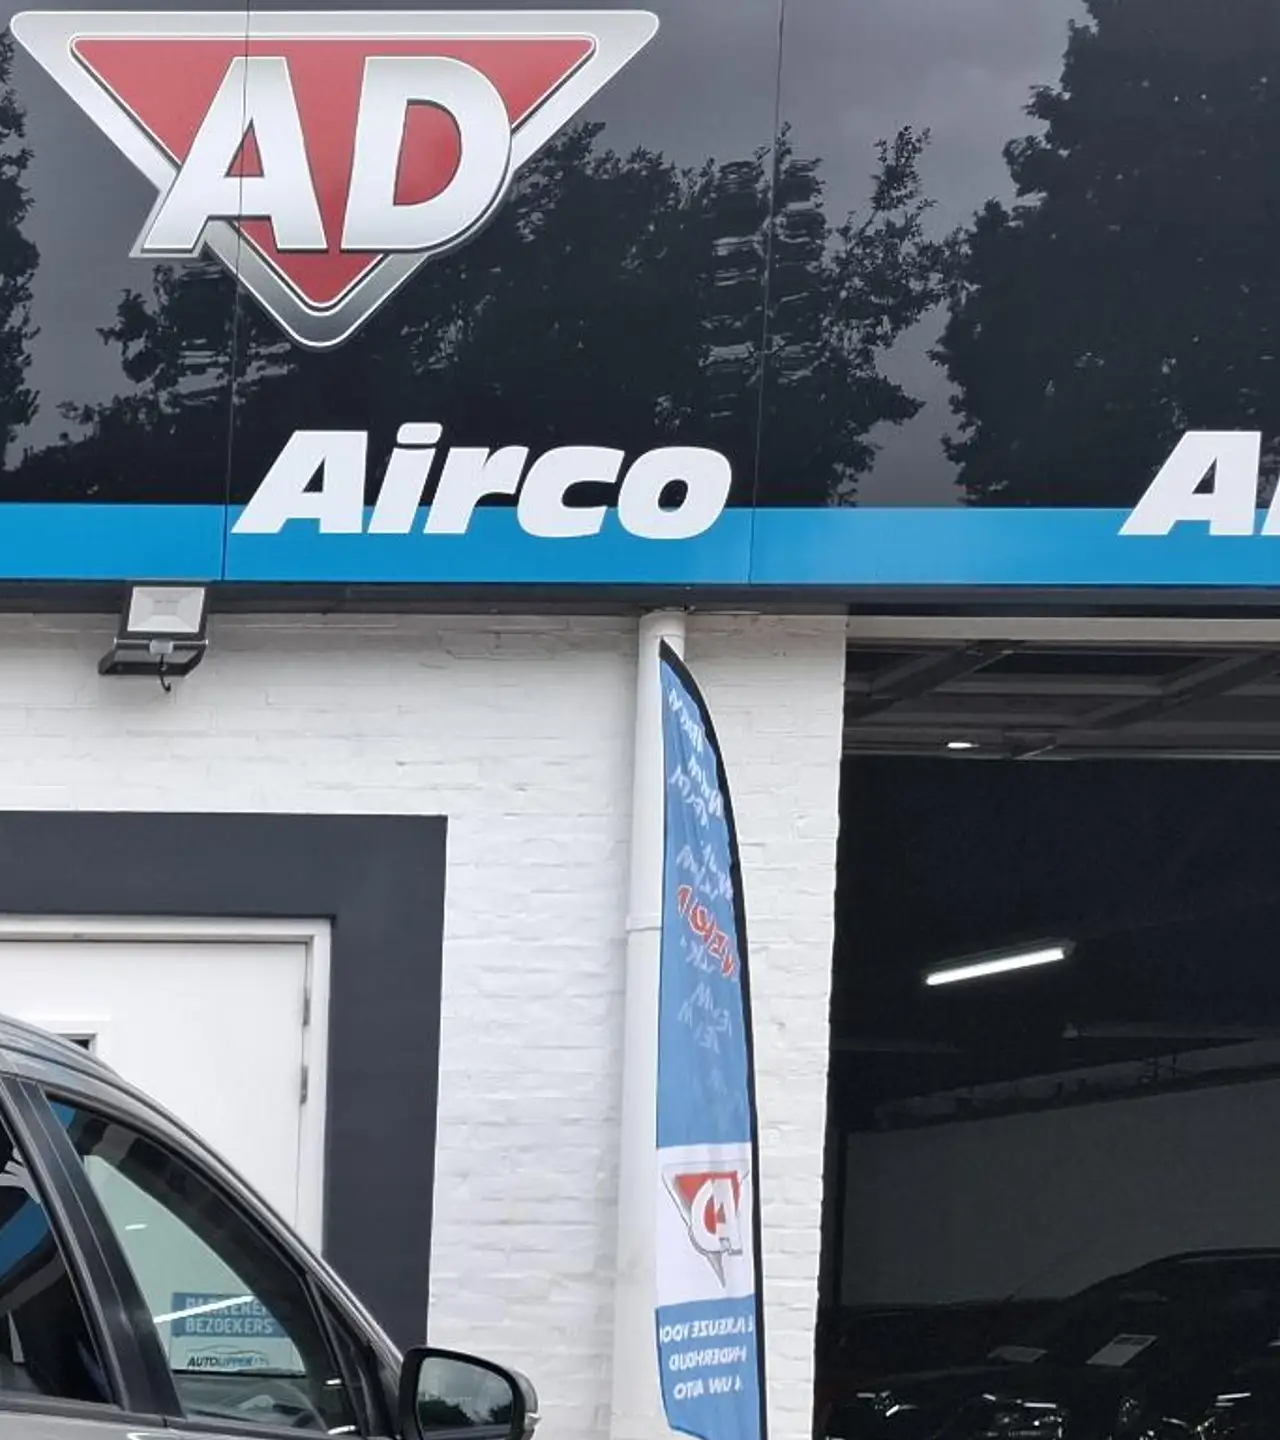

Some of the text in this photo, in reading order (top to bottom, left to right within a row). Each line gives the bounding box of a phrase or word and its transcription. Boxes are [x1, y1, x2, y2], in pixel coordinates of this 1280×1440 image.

[140, 54, 514, 252] AD
[229, 422, 732, 540] Airco
[1117, 430, 1280, 536] A
